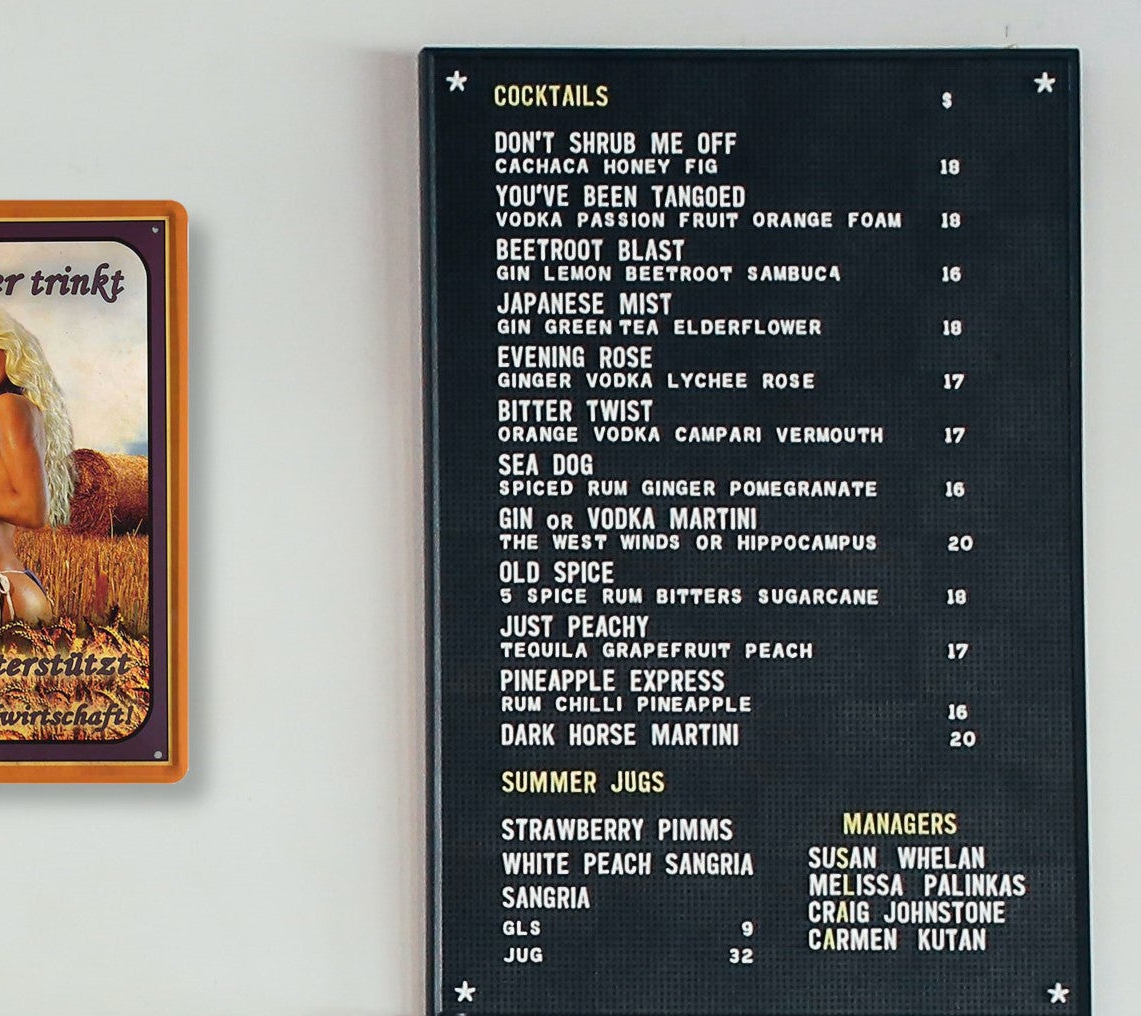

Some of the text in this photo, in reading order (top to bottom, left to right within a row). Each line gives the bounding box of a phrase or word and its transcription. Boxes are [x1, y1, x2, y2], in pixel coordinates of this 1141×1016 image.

[494, 84, 609, 107] COCKTAILS
[941, 91, 953, 110] $
[494, 130, 737, 155] DON'T SHRUB ME OFF
[495, 157, 718, 175] CACHACA HONEY FIG
[940, 158, 960, 176] 18
[495, 183, 746, 209] YOU'VE BEEN TANGOED
[495, 211, 902, 229] VODKA PASSION FRUIT ORANGE FOAM
[941, 212, 961, 229] 18
[496, 238, 685, 262] BEETROOT BLAST
[30, 263, 125, 303] trinkt
[496, 265, 841, 282] GIN LEMON BEETROOT SAMBUCA
[941, 266, 962, 283] 16
[496, 291, 672, 316] JAPANESE MIST
[497, 318, 822, 336] GIN GREEN TEA ELDERFLOWER
[942, 319, 962, 336] 18
[497, 345, 653, 370] EVENING ROSE
[497, 372, 815, 390] GINGER VODKA LYCHEE ROSE
[943, 373, 965, 390] 17
[498, 399, 653, 423] BITTER TWIST
[497, 425, 884, 444] ORANGE VODKA CAMPARI VERMOUTH
[944, 427, 966, 444] 17
[498, 453, 594, 476] SEA DOG
[499, 479, 878, 498] SPICED RUM GINGER POMEGRANATE
[945, 480, 965, 498] 16
[499, 506, 757, 531] GIN OR VODKA MARTINI
[499, 533, 877, 552] THE WEST WINDS OR HIPPOCAMPUS
[947, 535, 974, 552] 20
[499, 560, 614, 584] OLD SPICE
[499, 587, 879, 606] 5 SPICE RUM BITTERS SUGARCANE
[947, 588, 967, 605] 18
[499, 614, 649, 639] JUST PEACHY
[500, 641, 813, 659] TEQUILA GRAPEFRUIT PEACH
[947, 643, 969, 660] 17
[500, 668, 725, 693] PINEAPPLE EXPRESS
[501, 695, 752, 713] RUM CHILLI PINEAPPLE
[947, 703, 968, 721] 16
[501, 722, 739, 747] DARK HORSE MARTINI
[949, 730, 977, 748] 20
[501, 770, 665, 794] SUMMER JUGS
[501, 817, 734, 842] STRAWBERRY PIMMS
[843, 812, 958, 836] MANAGERS
[502, 851, 754, 876] WHITE PEACH SANGRIA
[808, 845, 985, 870] SUSAN WHELAN
[809, 873, 1027, 898] MELISSA PALINKAS
[502, 885, 591, 910] SANGRIA
[808, 900, 1006, 924] CRAIG JOHNSTONE
[502, 920, 541, 936] GLS
[741, 920, 754, 937] 9
[808, 927, 986, 952] CARMEN KUTAN
[503, 946, 543, 963] JUG
[729, 947, 754, 964] 32
